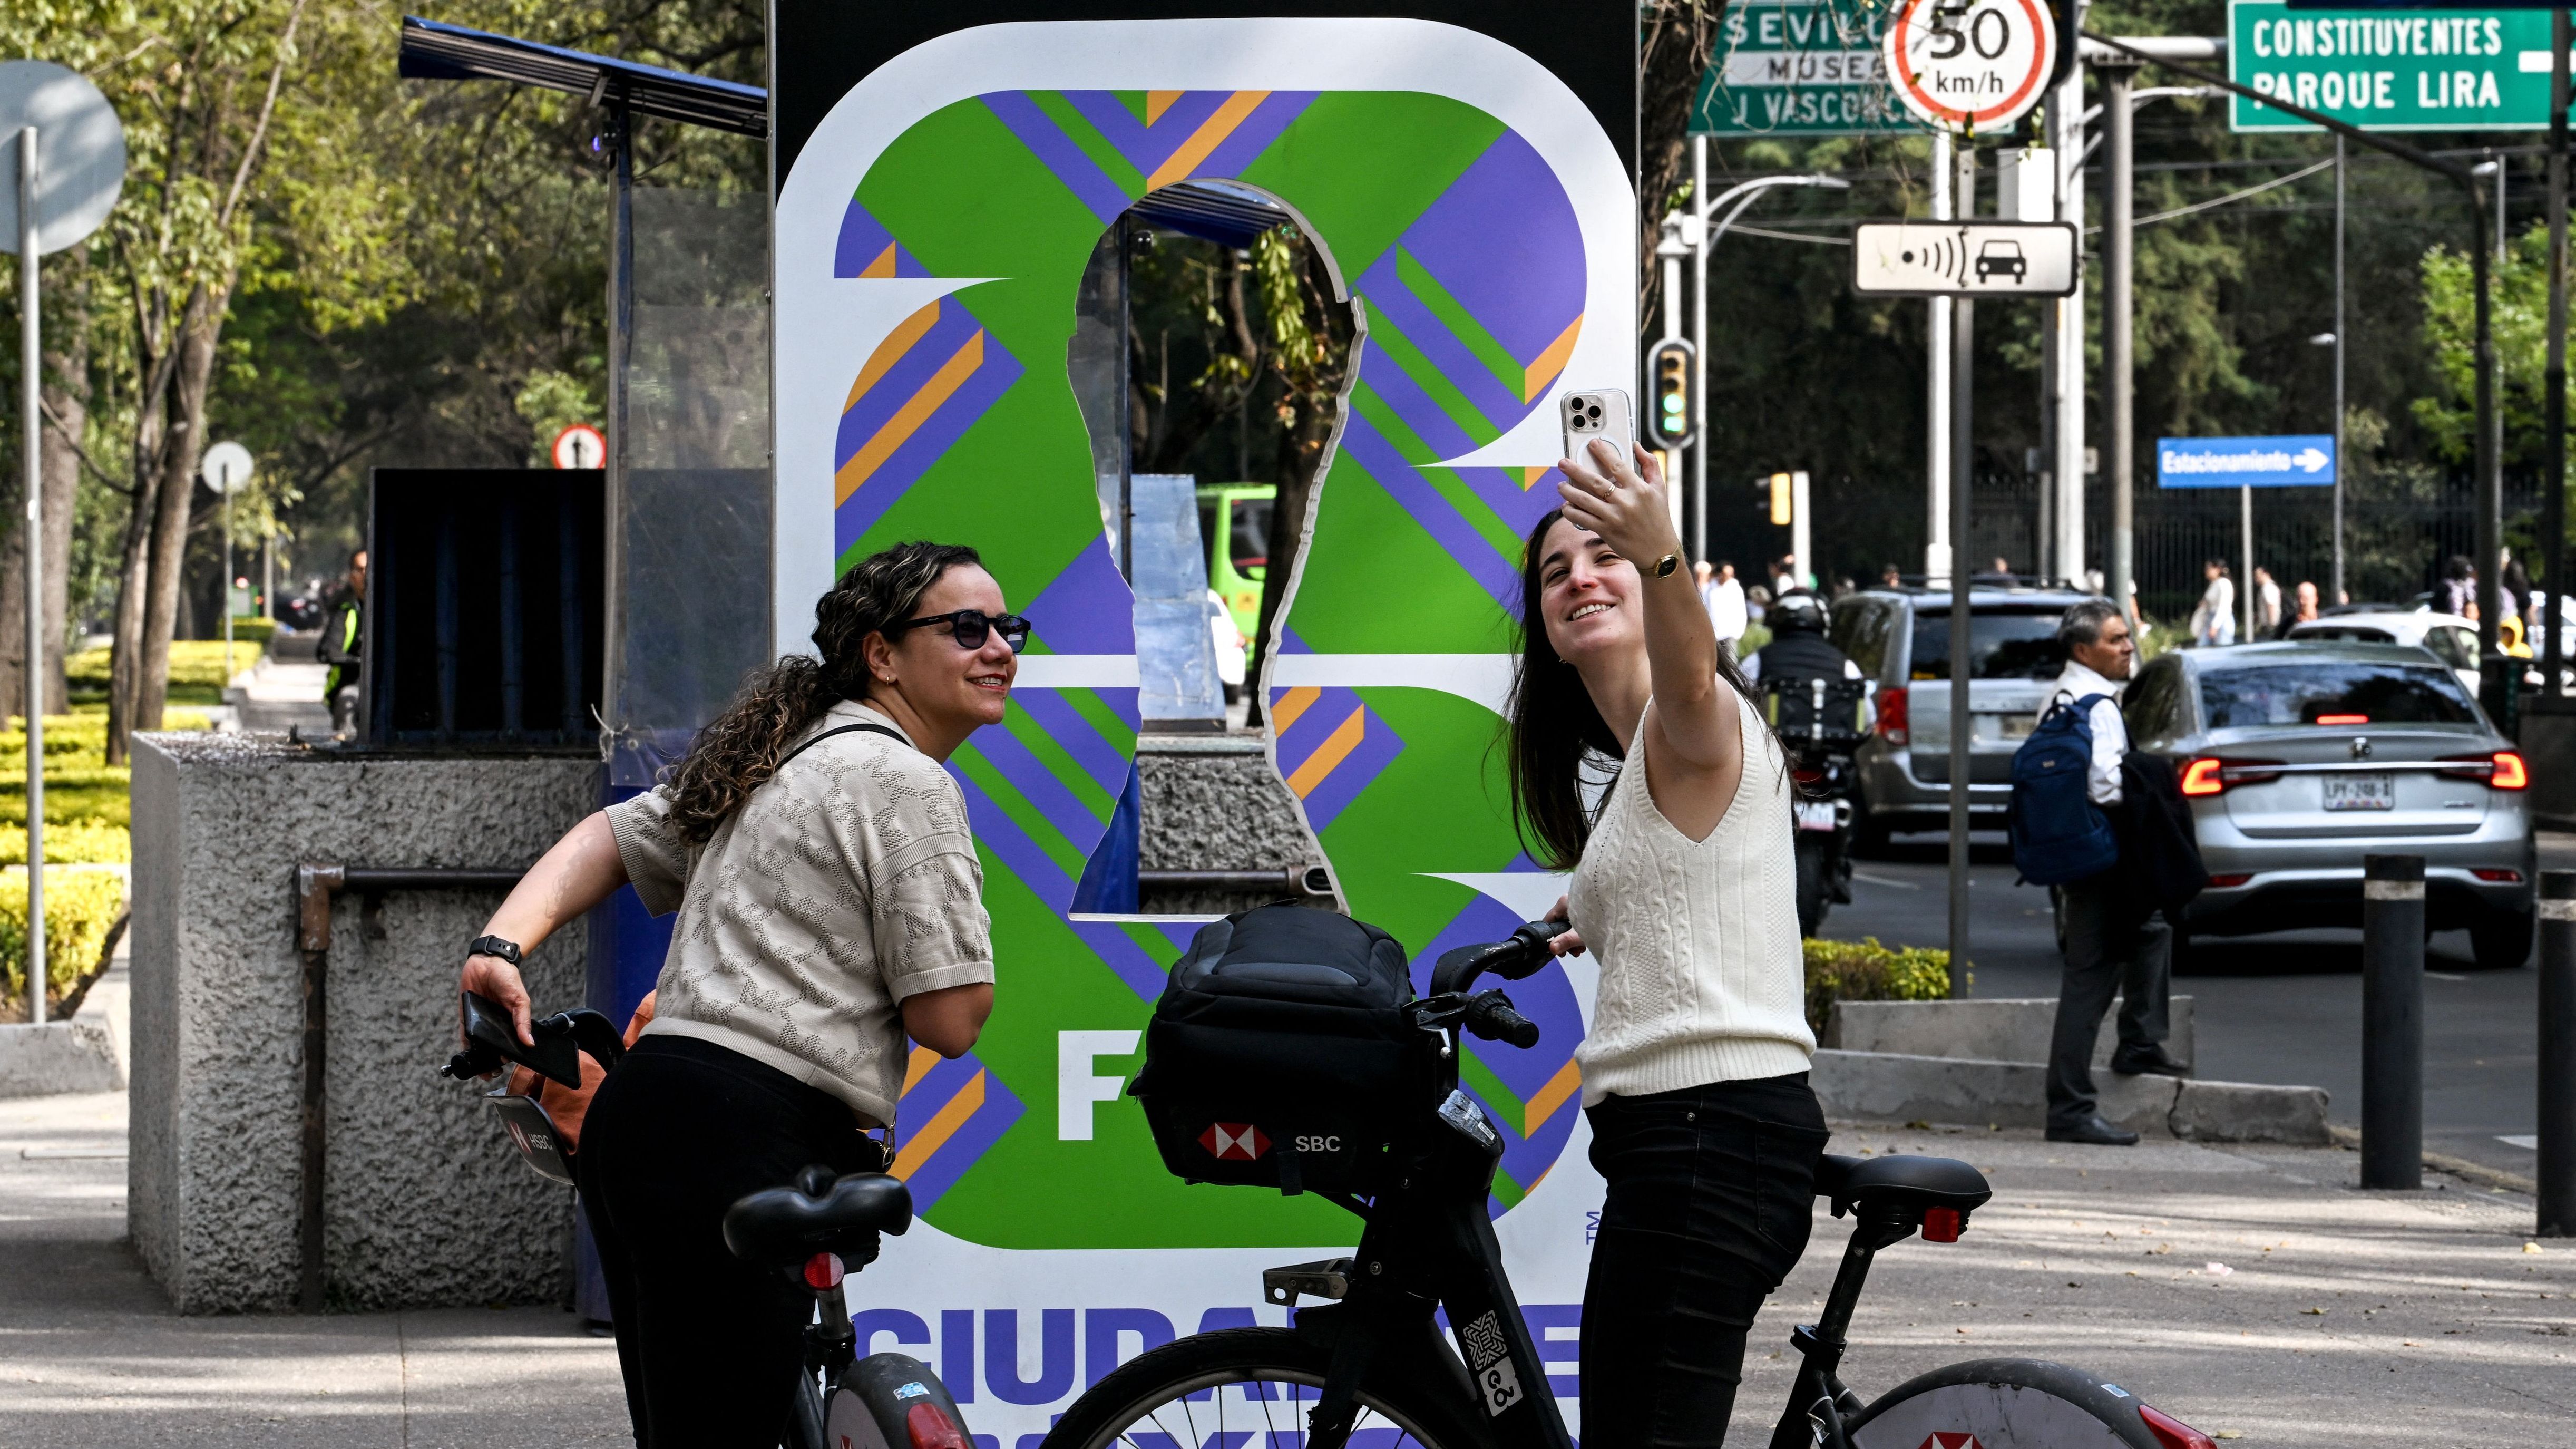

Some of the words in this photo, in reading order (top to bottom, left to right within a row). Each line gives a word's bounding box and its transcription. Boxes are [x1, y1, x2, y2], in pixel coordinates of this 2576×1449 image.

[1724, 11, 1882, 44] SEVILL
[1930, 8, 2009, 60] 50
[2253, 18, 2502, 57] CONSTITUYENTES
[1936, 70, 2003, 94] km/h
[2253, 71, 2395, 110] PARQUE
[2418, 71, 2501, 108] LIRA
[2162, 449, 2291, 473] Estacionamiento
[528, 1133, 552, 1150] HSBC
[1295, 1135, 1341, 1153] SBC
